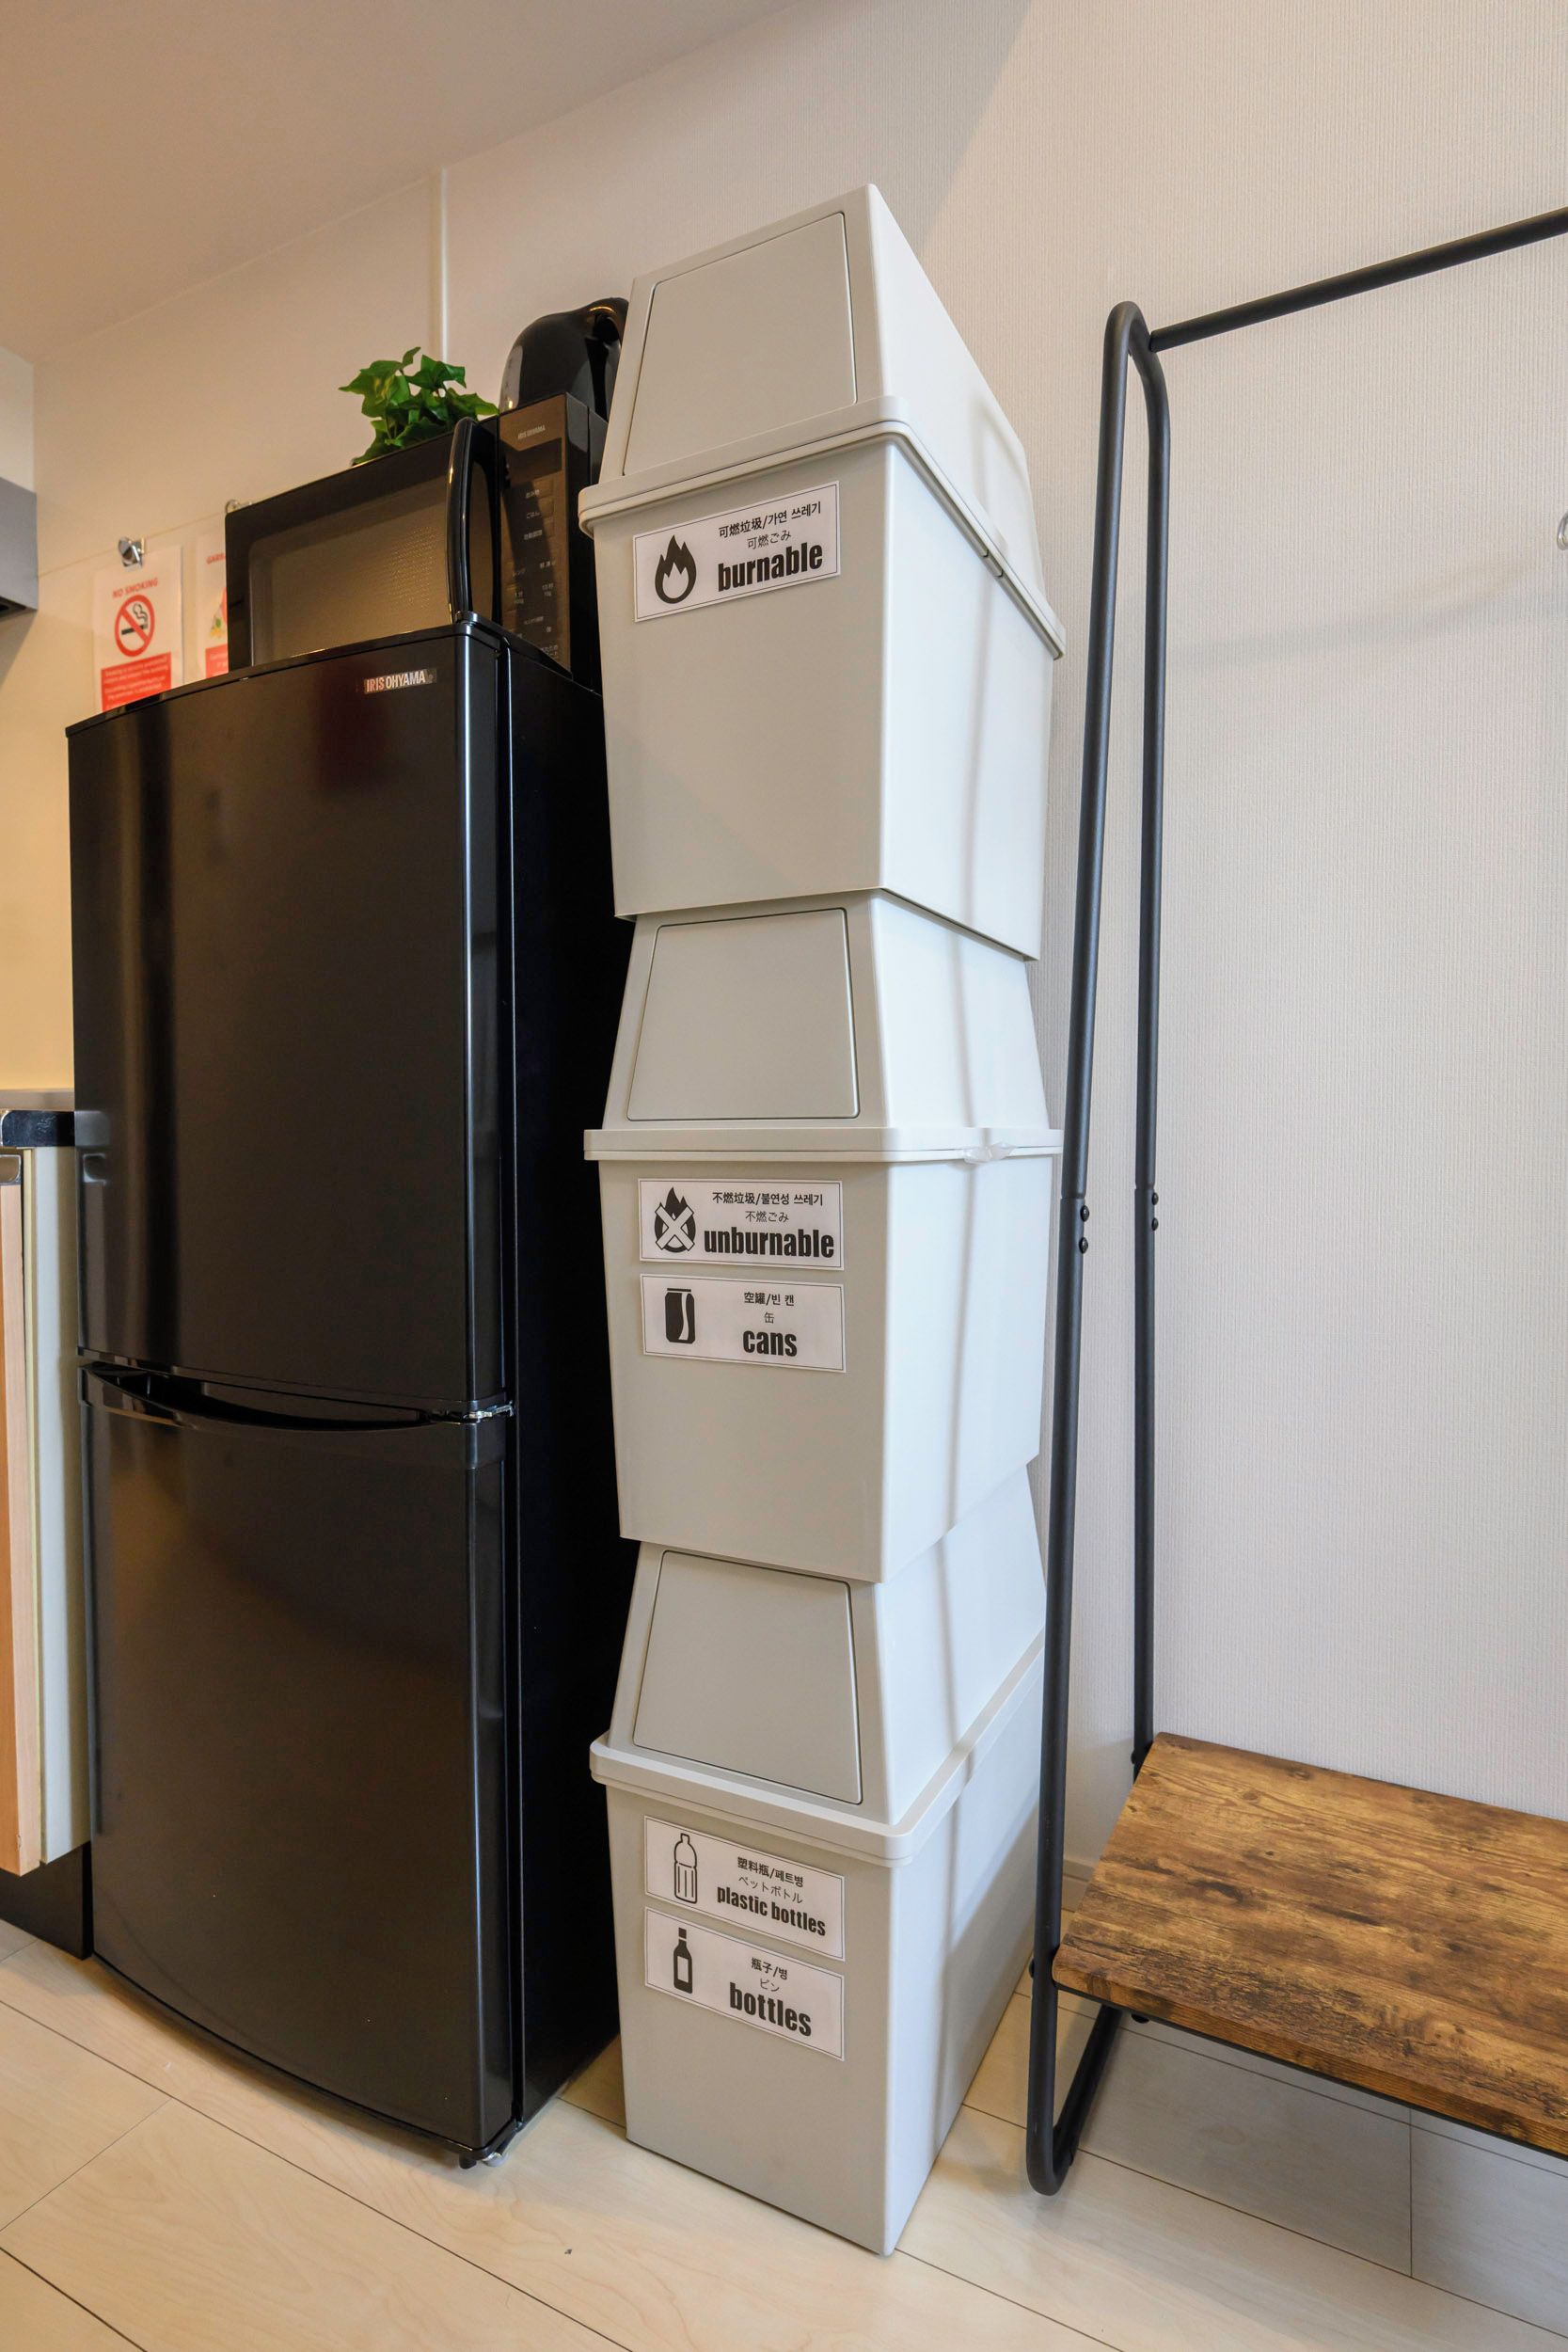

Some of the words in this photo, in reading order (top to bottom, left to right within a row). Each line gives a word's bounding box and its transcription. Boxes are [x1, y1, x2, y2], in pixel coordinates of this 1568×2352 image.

[719, 510, 787, 538] 可燃垃圾/가연
[791, 501, 821, 519] 쓰레기
[747, 530, 792, 550] 可燃ごみ
[718, 542, 823, 592] burnable
[112, 587, 123, 598] NO
[125, 577, 159, 596] SMOKING
[366, 677, 385, 692] IRIS
[386, 670, 426, 690] OHYAMA
[712, 1191, 790, 1206] 不燃垃圾/불연성
[793, 1193, 823, 1206] 쓰레기
[745, 1210, 789, 1223] 不燃ごみ
[704, 1227, 834, 1259] unburnable
[784, 1295, 795, 1307] 캔
[764, 1311, 775, 1324] 缶
[742, 1330, 798, 1357] cans
[736, 1856, 804, 1887] 塑料瓶/페트병
[717, 1886, 768, 1916] plastic
[771, 1901, 826, 1937] bottles
[751, 1957, 788, 1980] 瓶子/병
[759, 1978, 780, 1993] ビン
[729, 1981, 812, 2037] bottles
